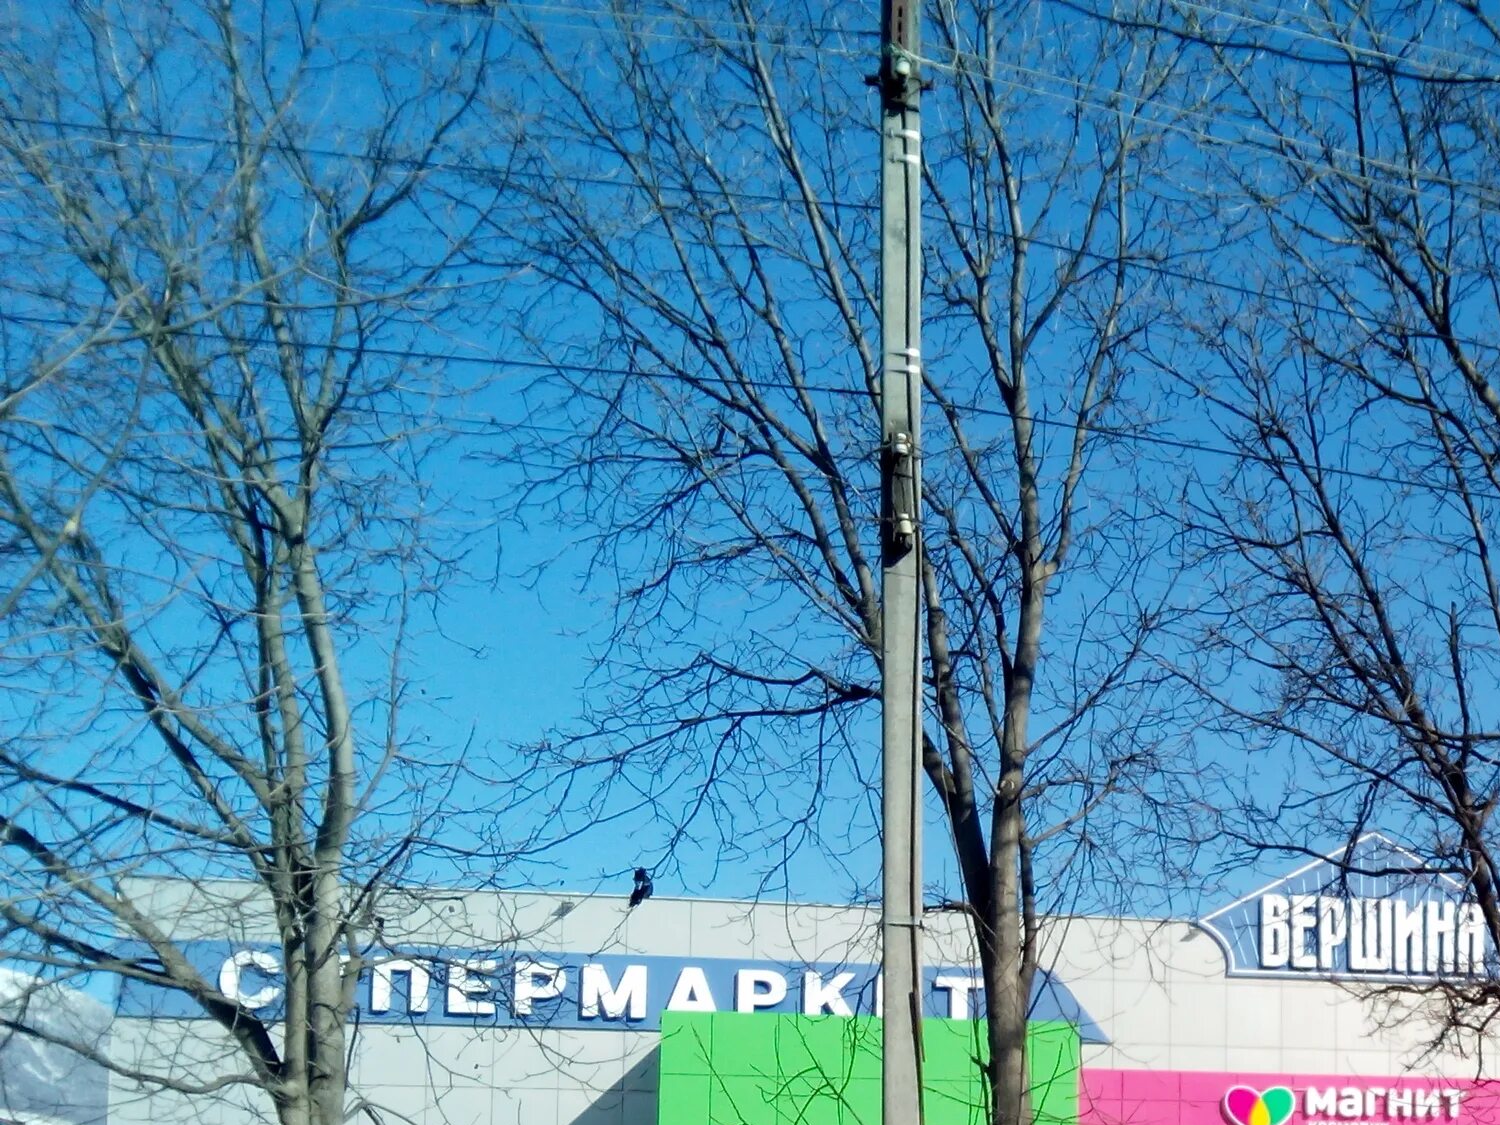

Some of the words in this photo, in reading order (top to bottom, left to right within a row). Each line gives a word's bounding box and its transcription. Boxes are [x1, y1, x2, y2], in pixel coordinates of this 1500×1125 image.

[1260, 894, 1486, 976] ВЕРШИНА
[218, 950, 986, 1020] СПЕРМАРКТ
[1304, 1086, 1467, 1119] магнит
